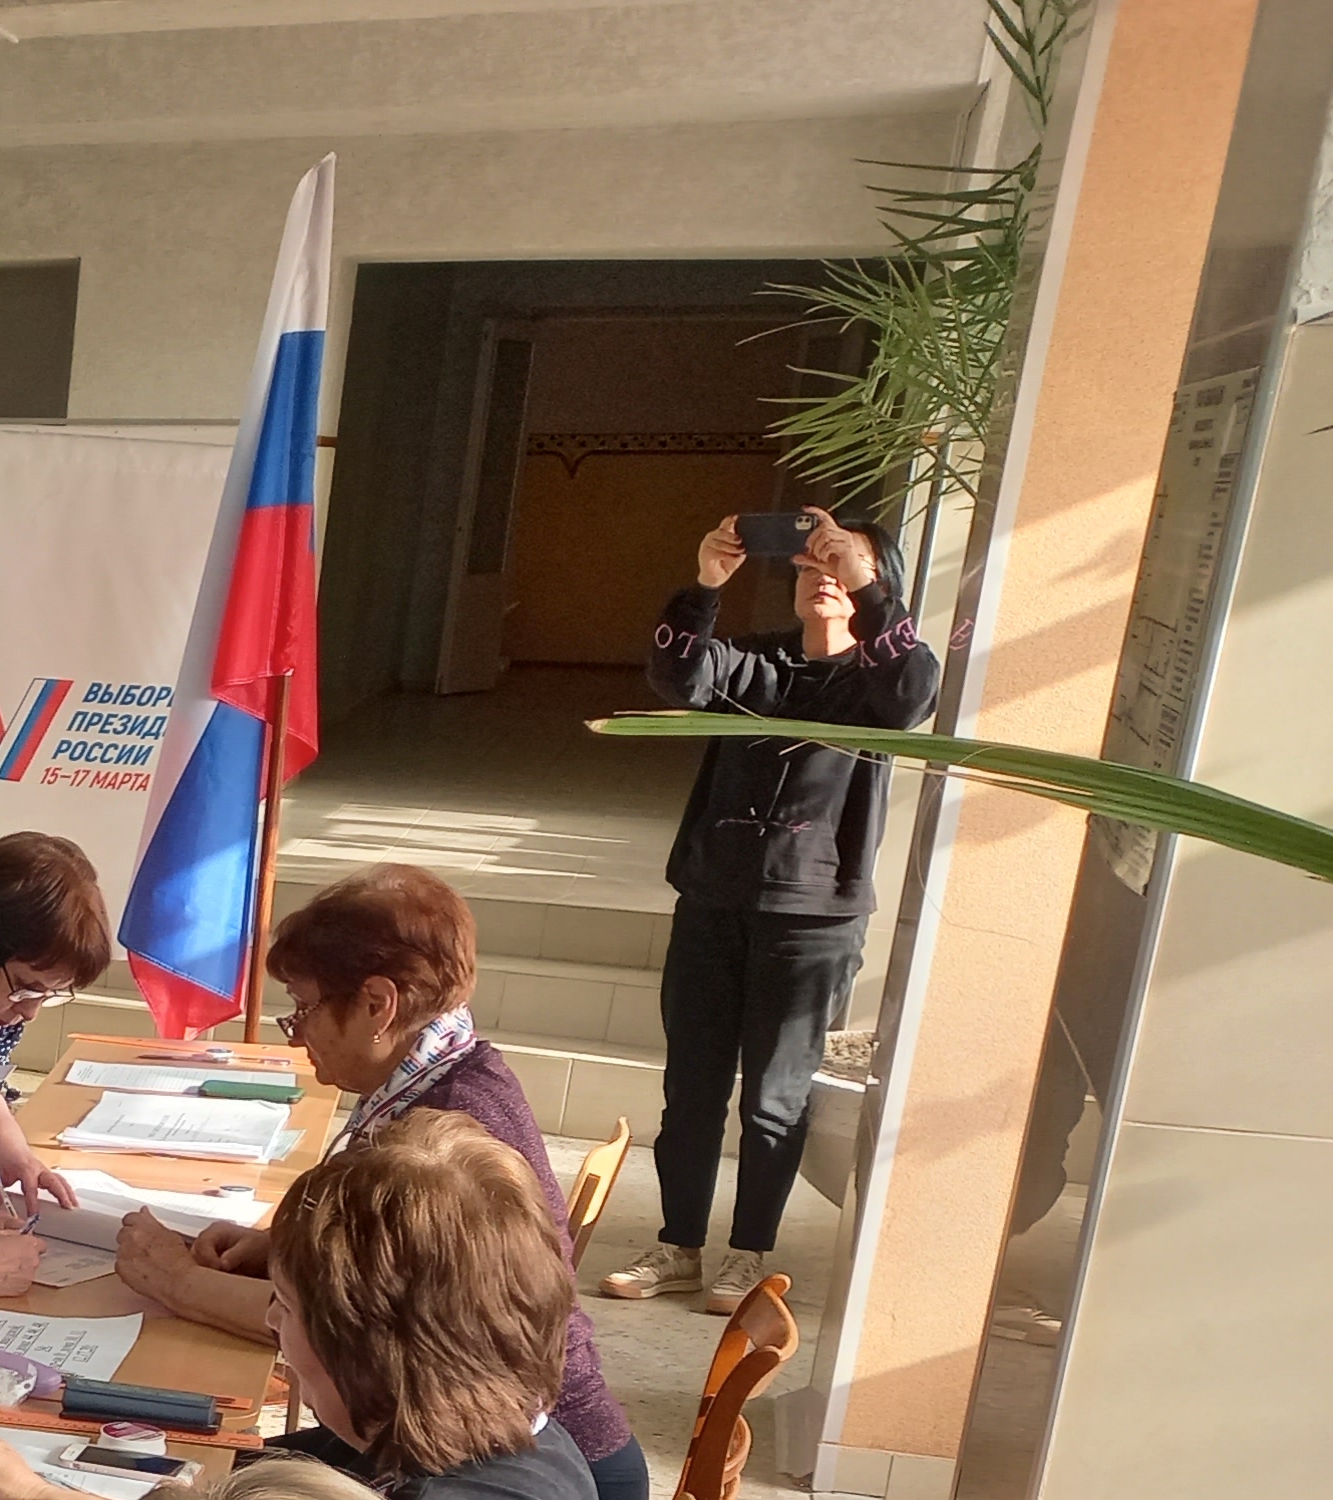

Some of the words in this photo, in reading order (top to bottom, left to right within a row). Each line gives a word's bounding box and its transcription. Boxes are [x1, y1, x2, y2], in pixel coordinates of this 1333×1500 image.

[82, 683, 174, 708] ВЫБОР
[66, 711, 167, 740] ПРЕЗИД
[52, 739, 154, 766] РОССИИ
[89, 770, 151, 792] МАРТА
